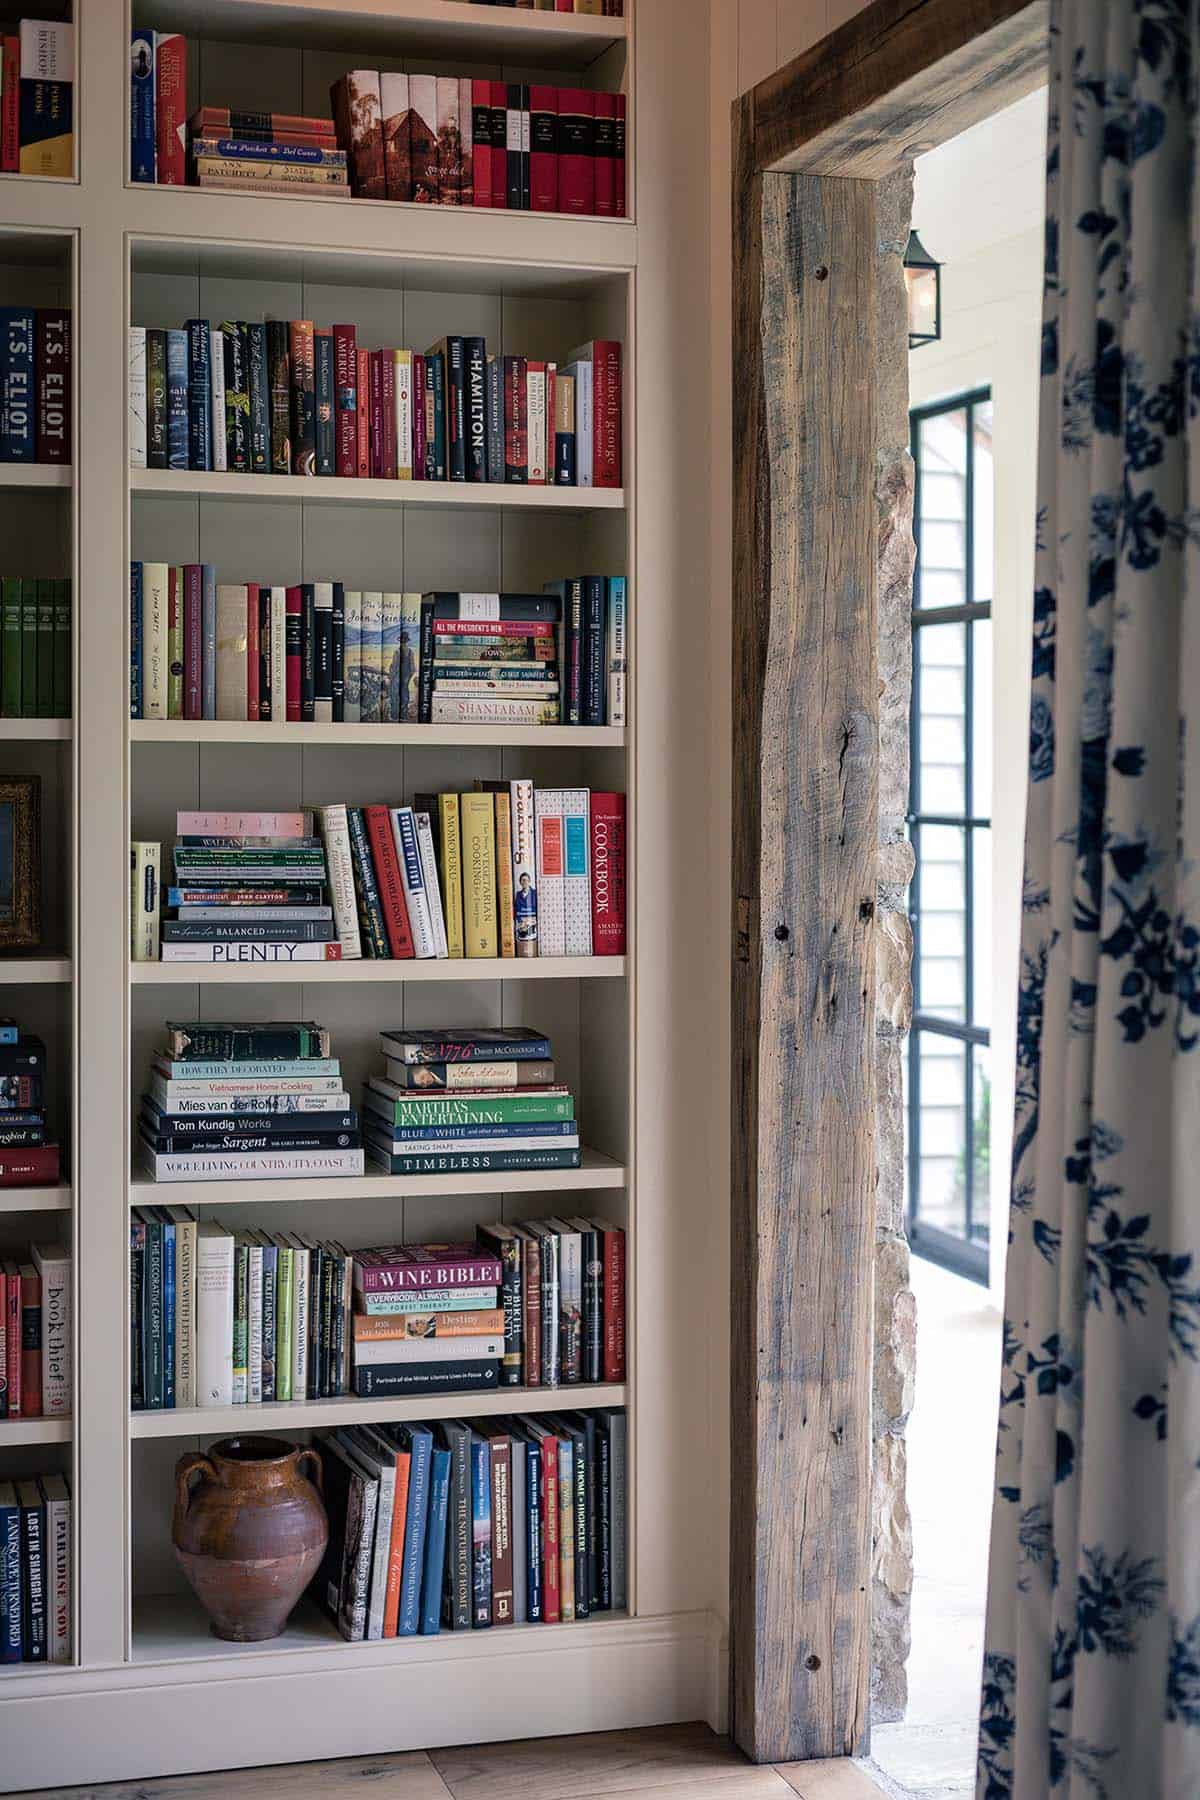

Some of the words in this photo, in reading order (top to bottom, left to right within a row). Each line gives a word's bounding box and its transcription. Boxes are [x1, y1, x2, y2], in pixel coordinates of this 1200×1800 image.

[9, 318, 28, 364] T.S.
[46, 319, 64, 364] T.S.
[295, 335, 303, 380] HANNAH
[338, 336, 347, 386] AMERICA
[348, 349, 356, 376] SOUL
[596, 367, 604, 397] banquet
[607, 353, 619, 415] elizabeth
[9, 372, 28, 440] ELIOT
[46, 373, 64, 441] ELIOT
[154, 387, 166, 408] Out
[470, 360, 484, 447] HAMILTON
[341, 413, 349, 456] MEACHAM
[605, 420, 617, 465] george
[346, 609, 370, 624] John
[437, 624, 446, 632] ALL
[446, 624, 457, 632] THE
[457, 703, 536, 715] SHANTARAM
[514, 783, 533, 865] Baking
[380, 841, 390, 857] ART
[400, 815, 413, 848] SCHOOL
[408, 865, 420, 885] FISH
[446, 815, 458, 881] MOMOFUKU
[471, 836, 482, 886] COOKING
[594, 822, 609, 914] COOKBOOK
[385, 869, 398, 901] SIMPLE
[481, 849, 492, 922] VEGETARIAN
[390, 902, 403, 928] FOOD
[215, 927, 266, 936] BALANCED
[212, 944, 298, 961] PLENTY
[440, 1042, 476, 1063] 1776
[181, 1067, 201, 1075] HOW
[205, 1065, 229, 1075] THEY
[231, 1064, 286, 1074] DECORATED
[208, 1083, 254, 1093] Vietnamese
[255, 1083, 280, 1091] Home
[281, 1082, 312, 1093] Cooking
[179, 1101, 206, 1111] Mies
[207, 1102, 227, 1110] van
[230, 1100, 250, 1110] der
[250, 1099, 278, 1110] Rohe
[400, 1101, 469, 1114] MARTHA'S
[400, 1111, 504, 1126] ENTERTAINING
[172, 1120, 195, 1131] Tom
[198, 1119, 236, 1132] Kundig
[237, 1118, 272, 1129] Works
[400, 1129, 425, 1138] BLUE
[435, 1128, 466, 1137] WHITE
[222, 1135, 268, 1151] Sargent
[403, 1143, 430, 1152] TAKING
[431, 1142, 454, 1150] SHAPE
[403, 1156, 491, 1170] TIMELESS
[151, 1240, 160, 1256] THE
[151, 1256, 161, 1304] DECORATIVE
[181, 1243, 190, 1291] CASTING
[379, 1268, 432, 1286] WINE
[437, 1266, 493, 1284] BIBLE
[611, 1255, 619, 1281] PAPER
[265, 1271, 273, 1302] TROUT
[48, 1287, 64, 1334] book
[181, 1291, 190, 1317] WITH
[390, 1304, 416, 1312] FOREST
[419, 1302, 452, 1310] THERAPY
[502, 1295, 512, 1341] PLENTY
[512, 1295, 522, 1334] BIRTH
[151, 1305, 160, 1339] CARPET
[181, 1318, 190, 1350] LEFTY
[265, 1303, 273, 1345] HUNTING
[374, 1320, 390, 1328] JON
[440, 1314, 478, 1326] Destiny
[48, 1338, 64, 1382] thief
[181, 1351, 190, 1380] KREH
[375, 1376, 397, 1384] Portrait
[415, 1440, 427, 1492] CHARLOTTE
[577, 1458, 586, 1470] AT
[577, 1470, 586, 1498] HOME
[458, 1498, 468, 1520] THE
[27, 1512, 39, 1537] LOST
[410, 1519, 420, 1556] GARDEN
[577, 1503, 586, 1553] HIGHCLERE
[7, 1515, 21, 1579] LANDSCAPE
[29, 1540, 40, 1551] IN
[458, 1520, 468, 1561] NATURE
[55, 1520, 67, 1599] PARADISE
[458, 1563, 468, 1578] OF
[406, 1556, 418, 1616] INSPIRATIONS
[459, 1580, 468, 1609] HOME
[8, 1579, 21, 1623] TURNED
[9, 1624, 21, 1647] RED
[57, 1604, 67, 1638] NOW
